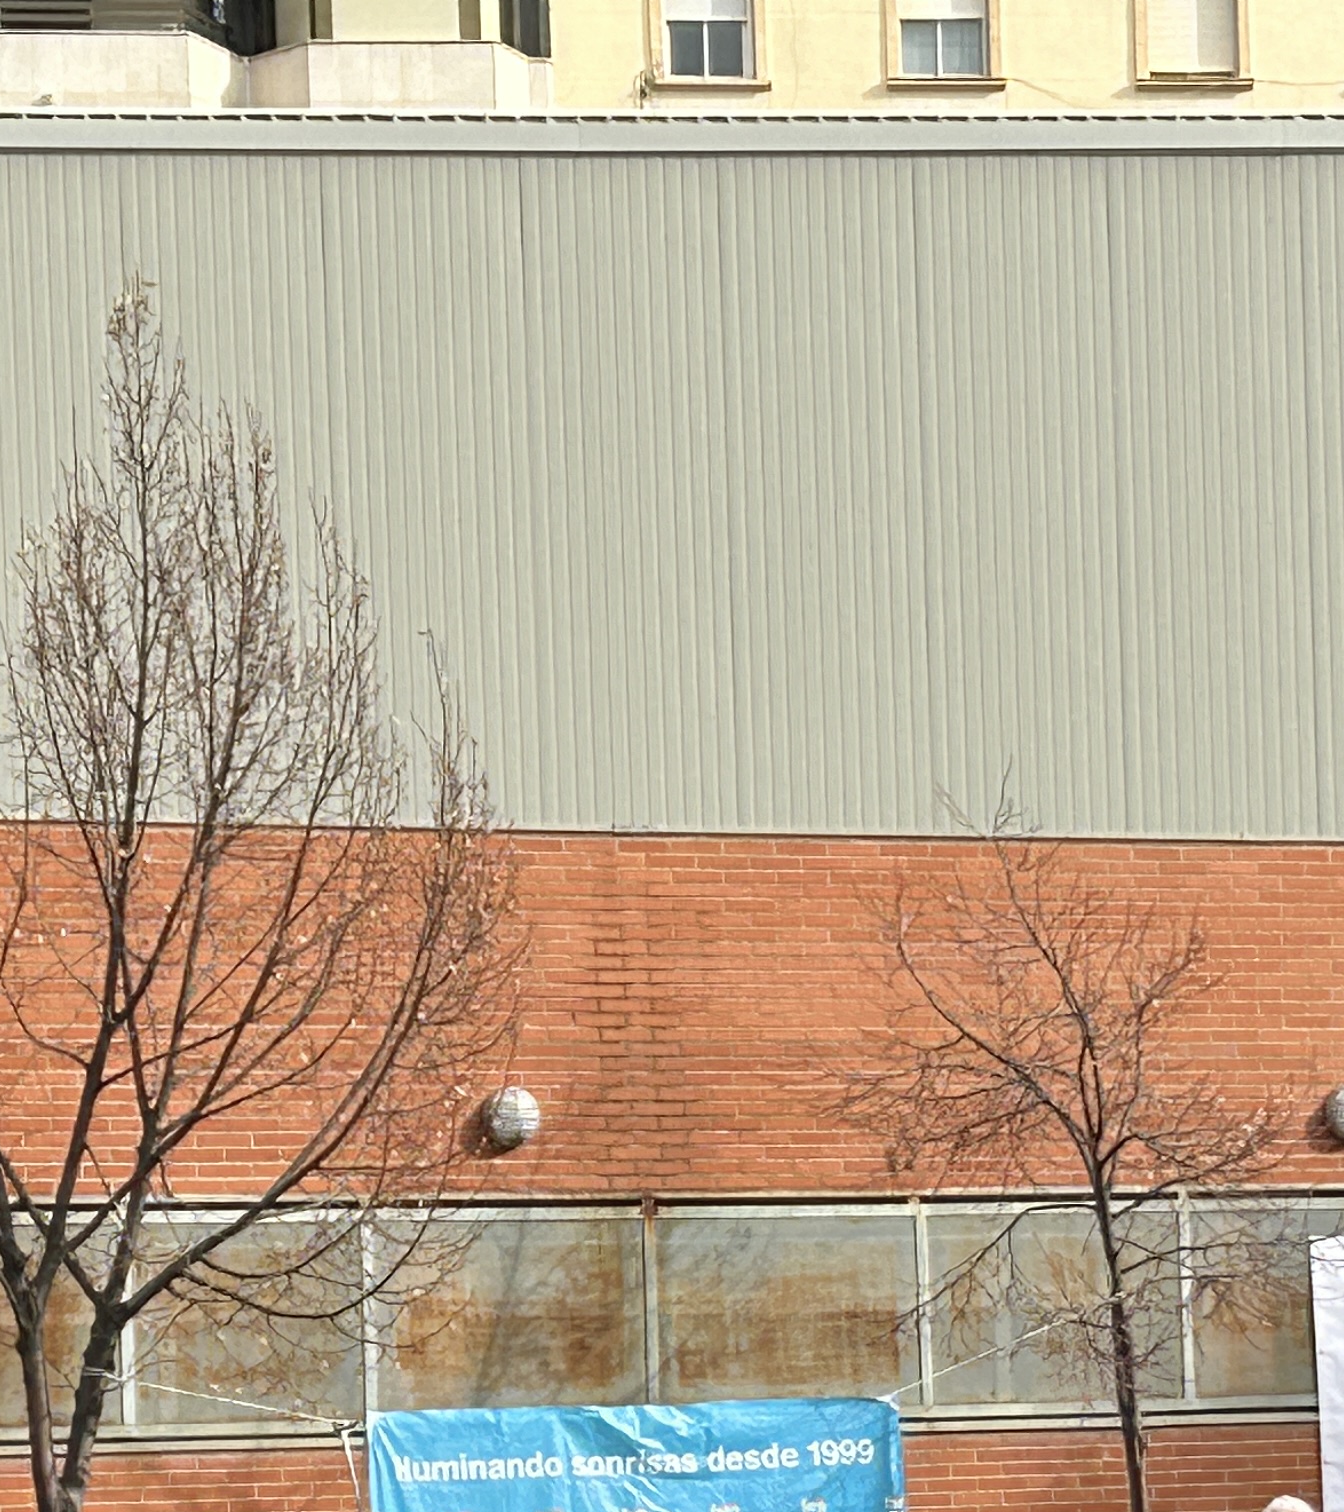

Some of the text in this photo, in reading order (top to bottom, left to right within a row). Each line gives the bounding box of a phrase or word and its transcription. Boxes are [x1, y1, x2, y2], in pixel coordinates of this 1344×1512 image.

[395, 1438, 875, 1482] Iluminando sonrisas desde 1999
